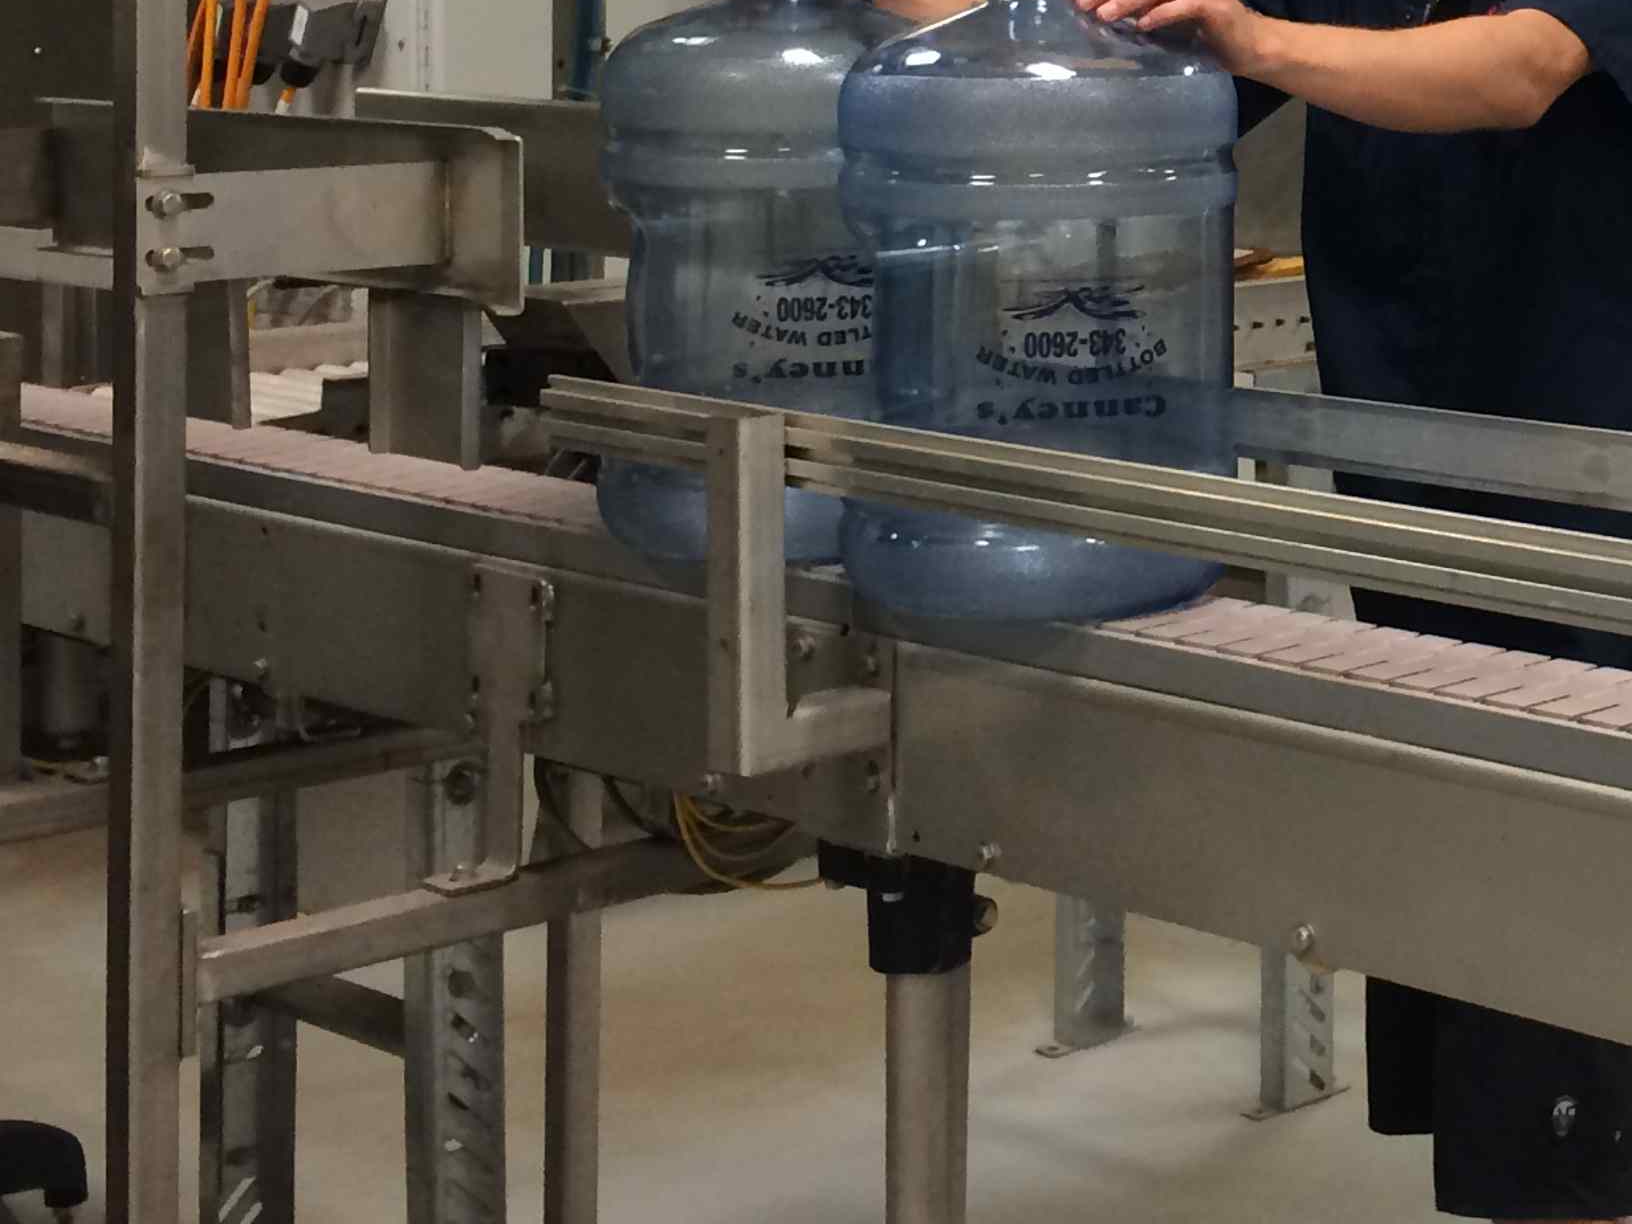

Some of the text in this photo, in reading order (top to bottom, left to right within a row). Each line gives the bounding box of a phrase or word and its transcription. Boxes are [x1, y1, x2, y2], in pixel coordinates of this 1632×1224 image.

[776, 294, 873, 322] 343-2600
[731, 311, 808, 347] WATER
[1023, 327, 1127, 358] 343-2600
[975, 338, 1168, 385] BOTTLED WATER
[976, 394, 1167, 425] Canney's
